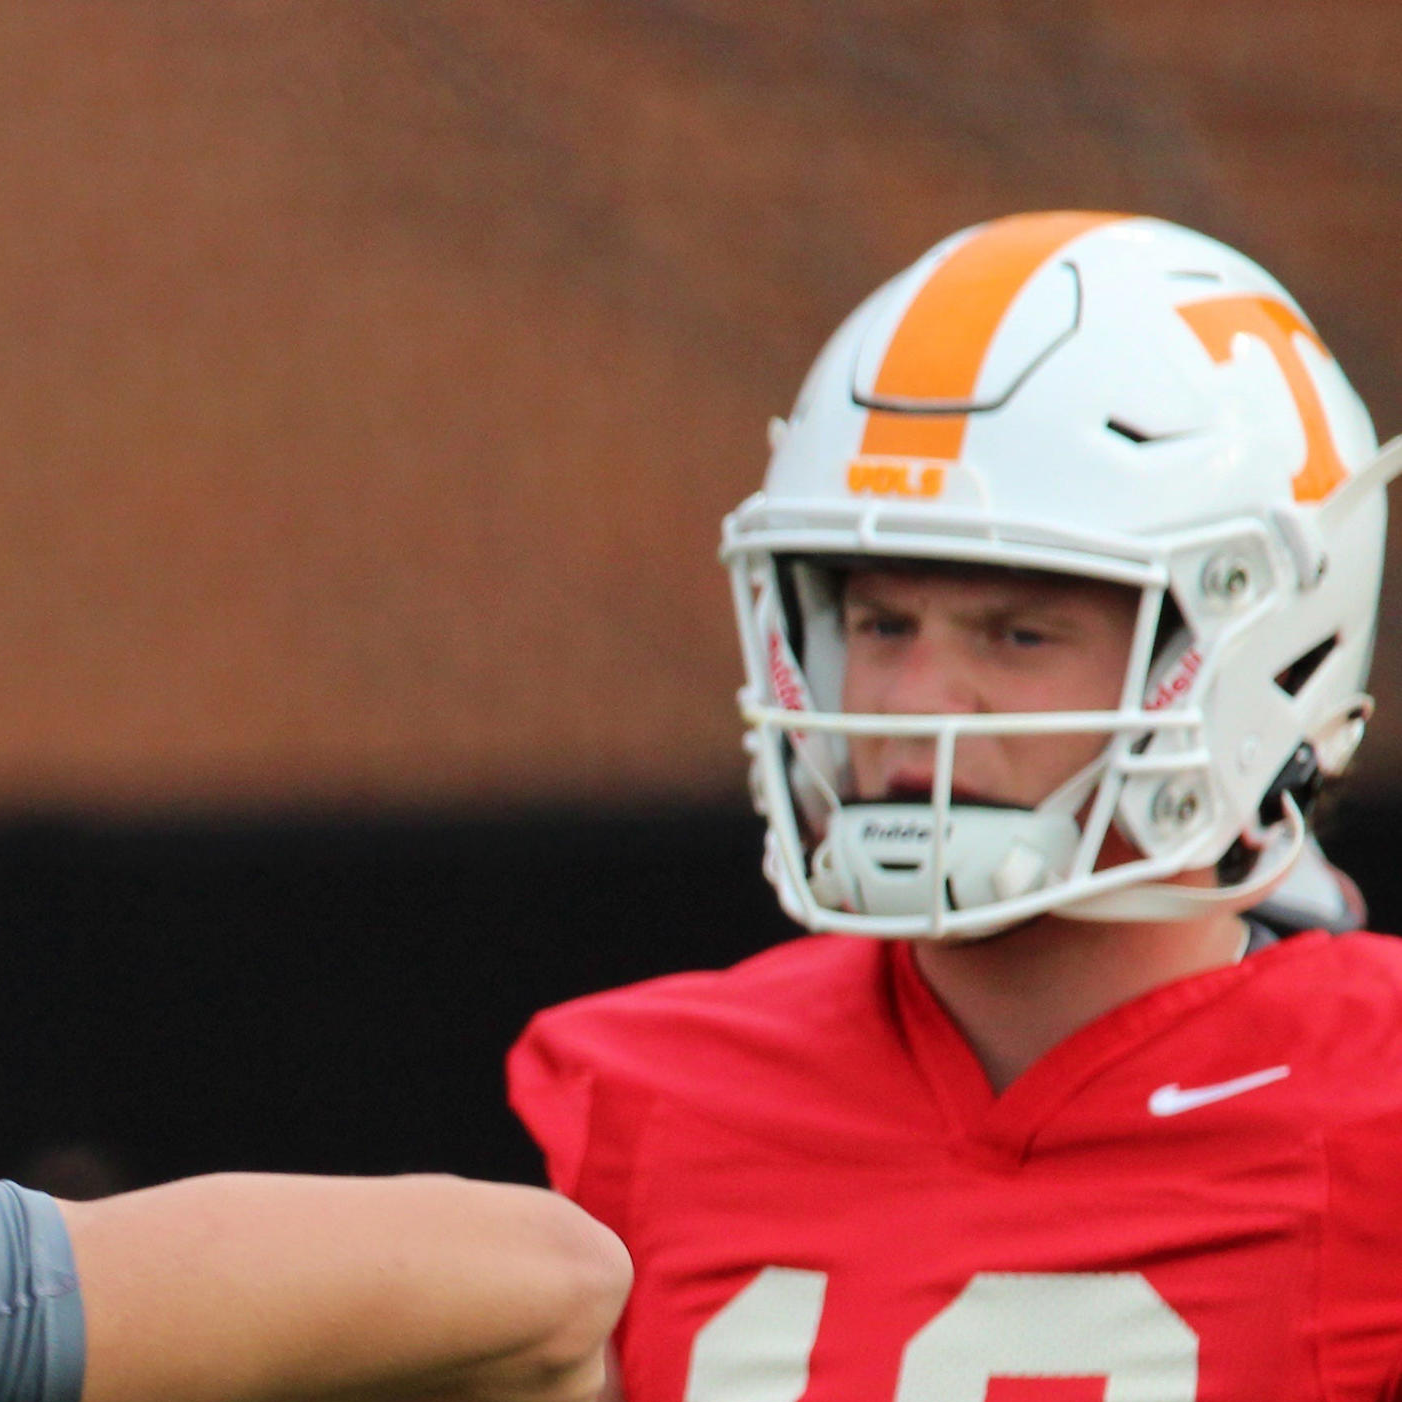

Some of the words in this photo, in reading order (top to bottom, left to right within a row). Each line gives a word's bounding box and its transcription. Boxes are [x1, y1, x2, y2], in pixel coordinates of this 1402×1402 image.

[1174, 293, 1350, 504] T
[847, 463, 944, 497] VOLS
[861, 820, 954, 841] Riddel
